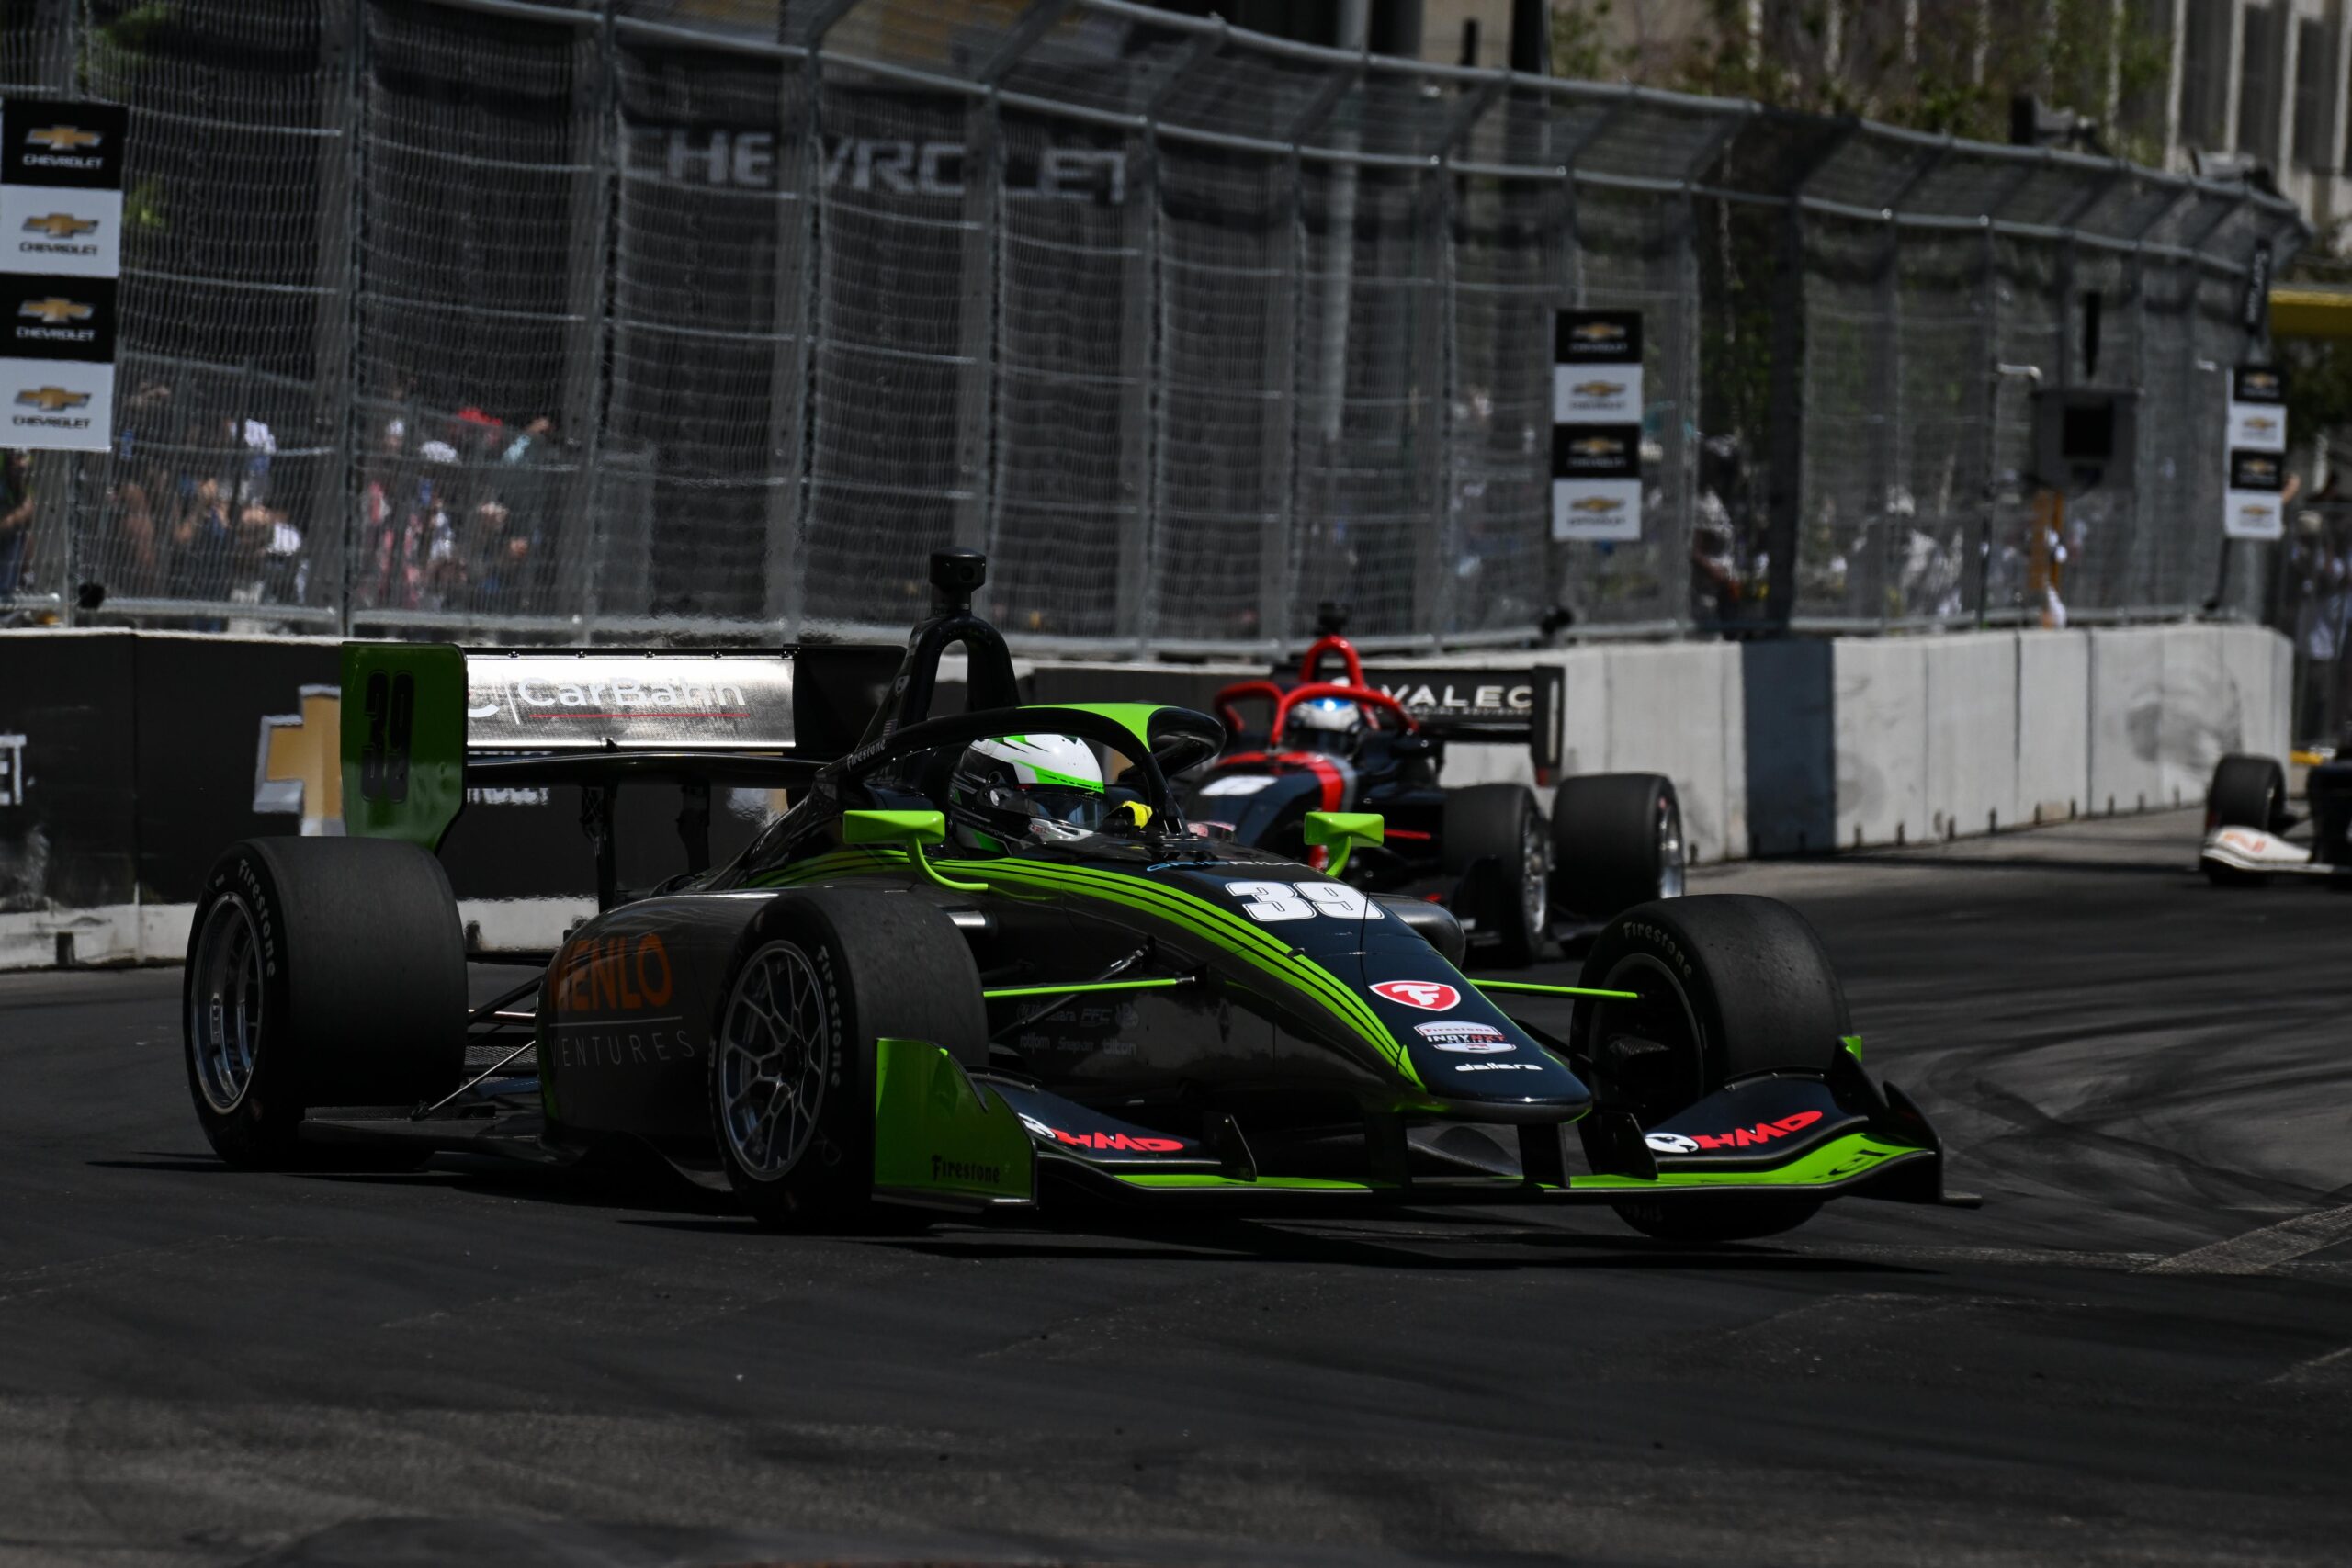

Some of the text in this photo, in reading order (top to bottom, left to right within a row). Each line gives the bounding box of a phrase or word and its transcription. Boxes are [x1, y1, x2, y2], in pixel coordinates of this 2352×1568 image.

[22, 154, 103, 170] CHEVROLET
[19, 242, 97, 256] CHEVROLET
[16, 327, 96, 343] CHEVROLET
[12, 415, 91, 429] CHEVROLET
[517, 677, 746, 707] CarBahn
[846, 739, 887, 772] Firestone
[1225, 881, 1385, 921] 39
[238, 858, 276, 977] Firestone
[1623, 921, 1692, 977] Firestone
[817, 945, 842, 1088] Firestone
[549, 1030, 695, 1066] VENTURES
[1455, 1062, 1544, 1072] dallara
[1050, 1127, 1185, 1152] HMD
[1690, 1110, 1824, 1149] HMD
[931, 1154, 1001, 1184] Firestone
